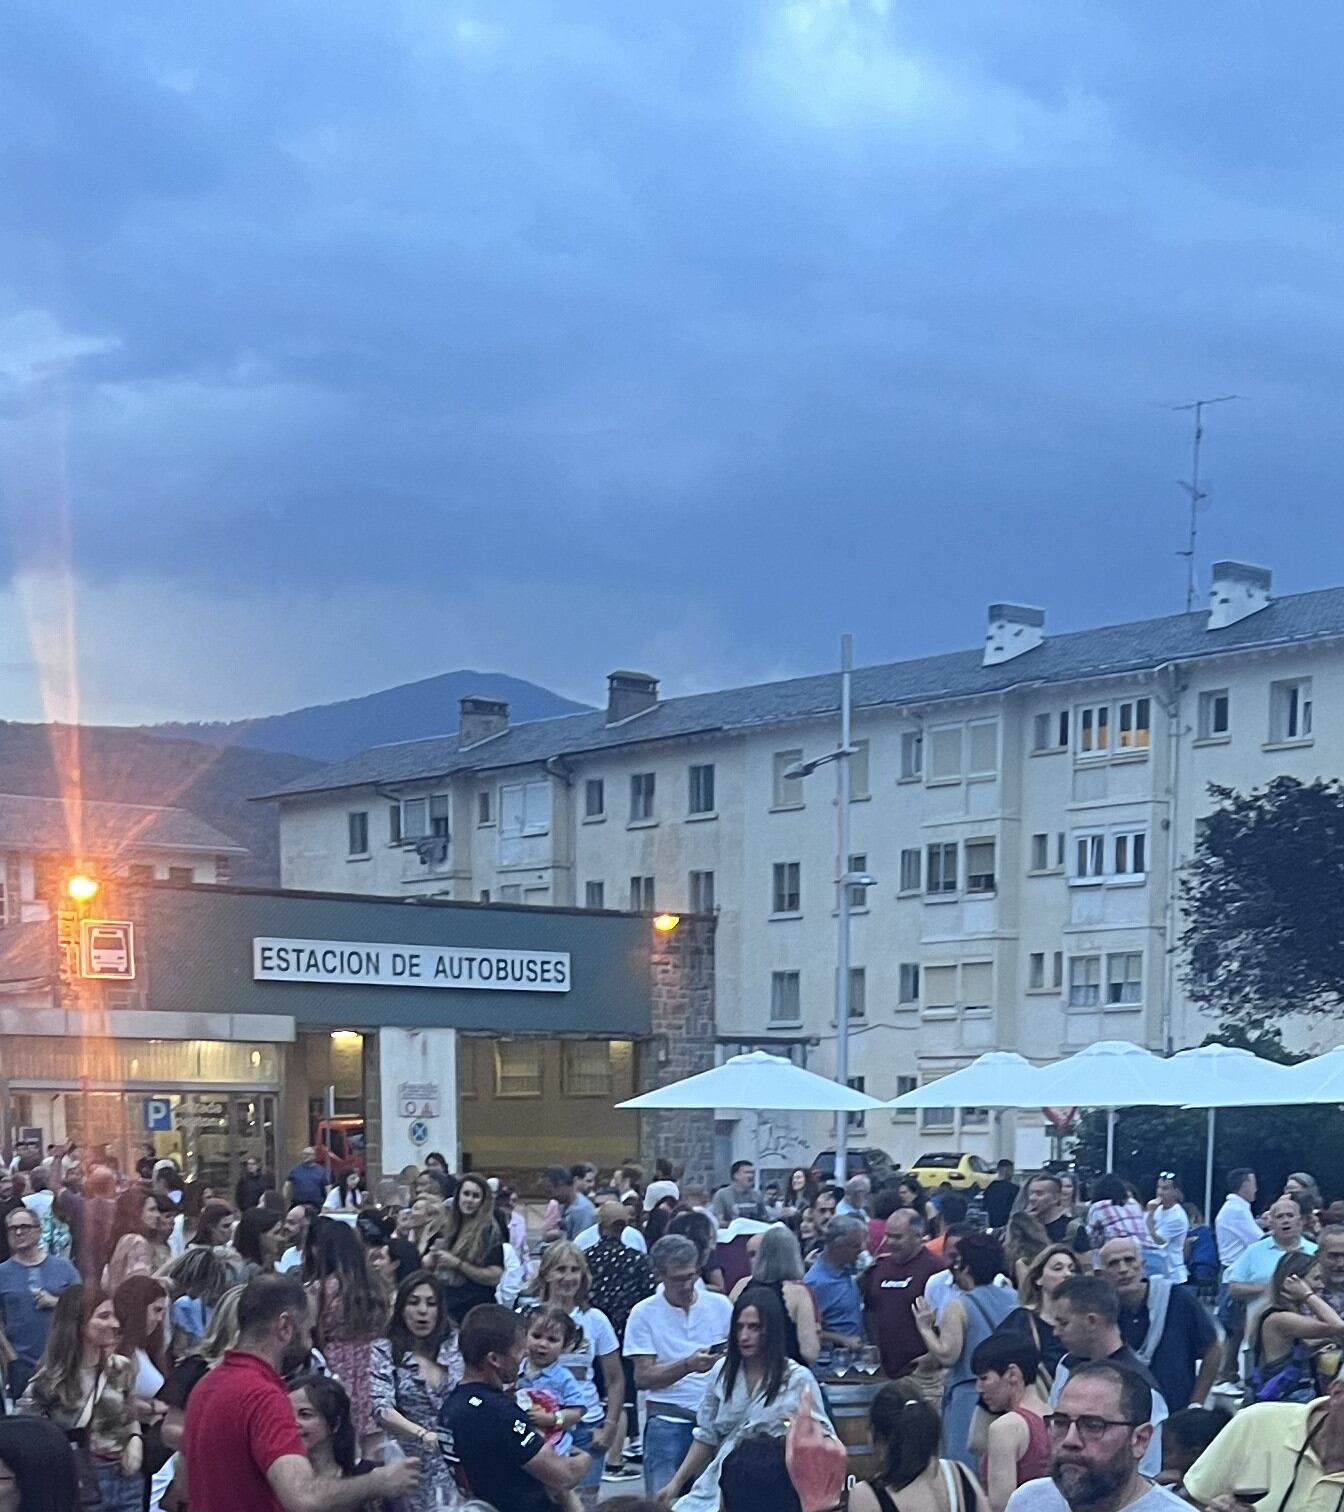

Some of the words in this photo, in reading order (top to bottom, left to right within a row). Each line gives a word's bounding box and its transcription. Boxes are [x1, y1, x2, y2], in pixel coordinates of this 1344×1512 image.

[260, 947, 381, 976] ESTACION
[392, 953, 421, 978] DE
[433, 955, 567, 984] AUTOBUSES
[147, 1101, 167, 1129] P
